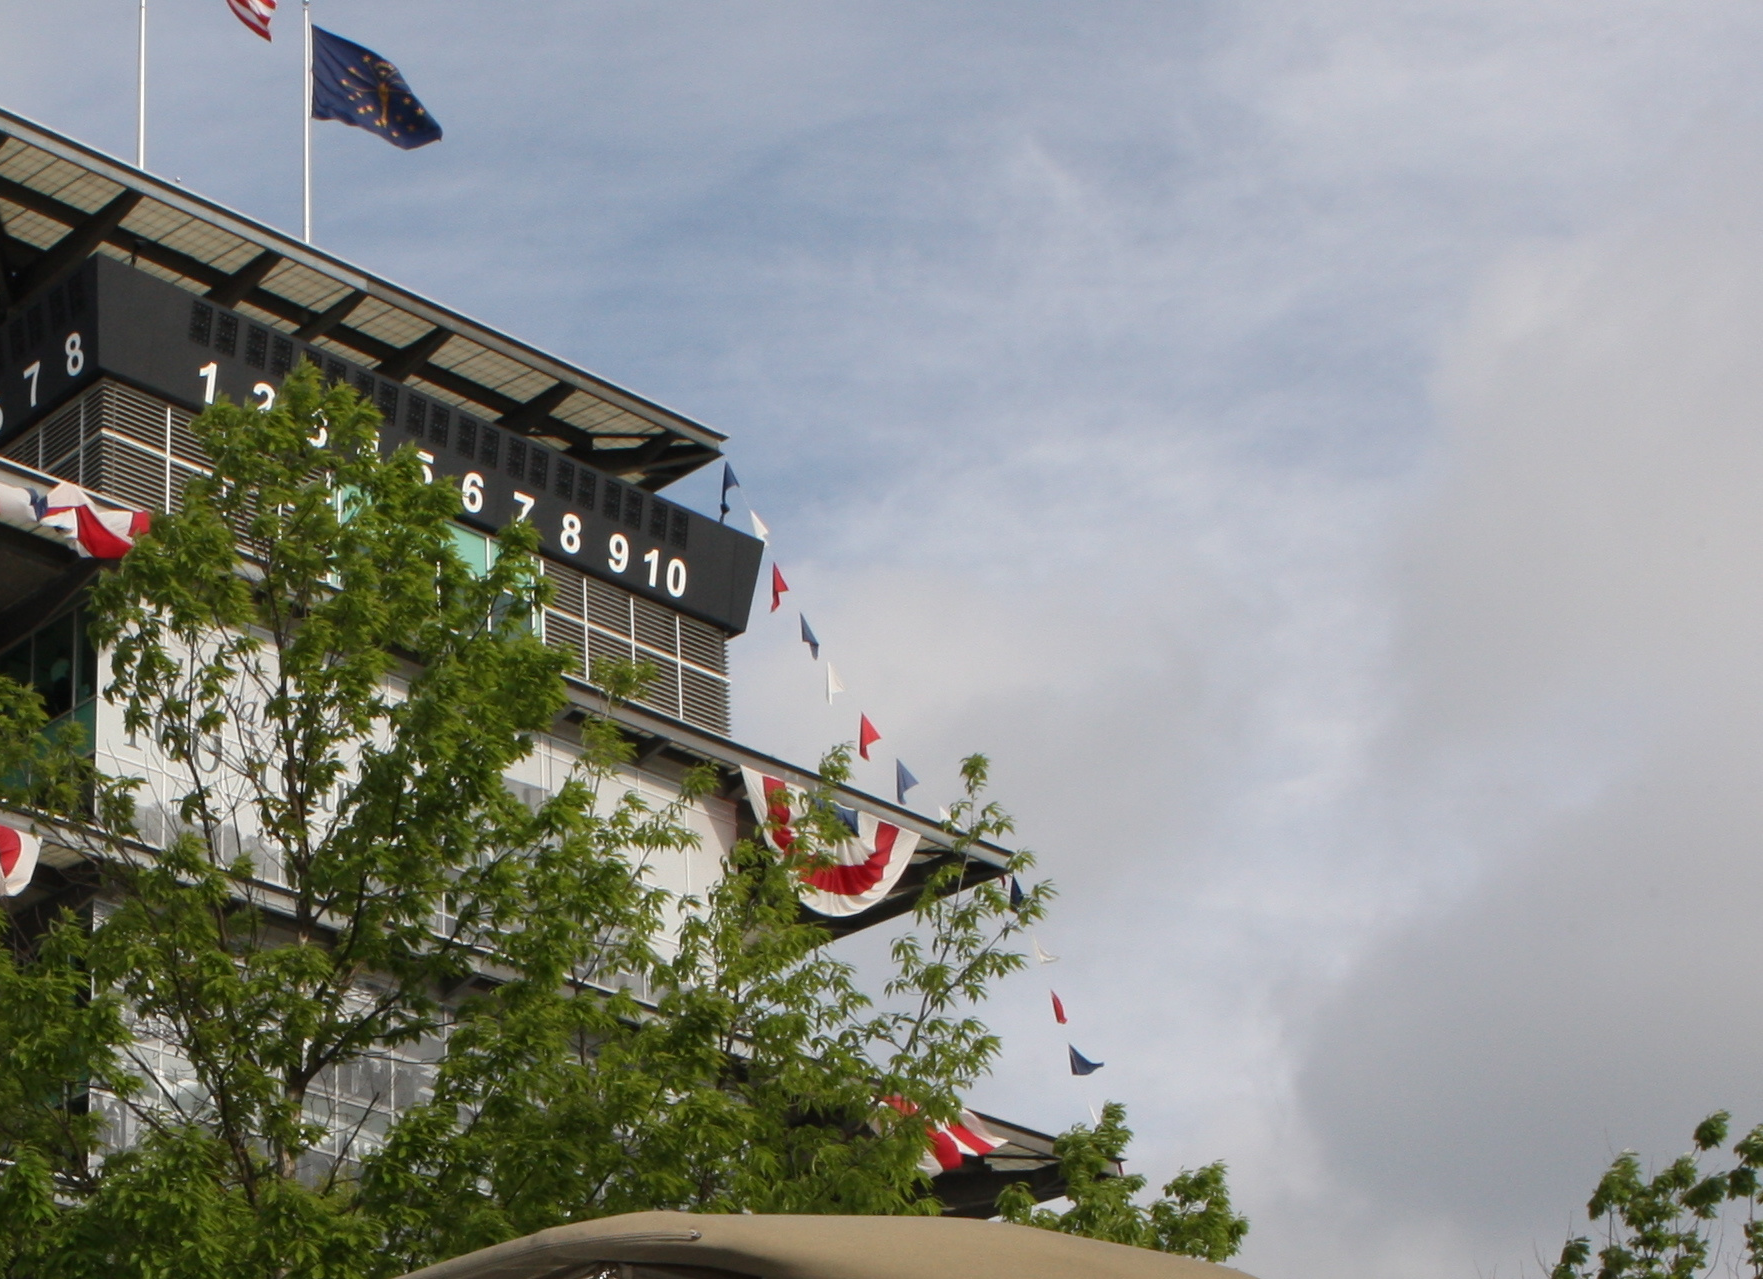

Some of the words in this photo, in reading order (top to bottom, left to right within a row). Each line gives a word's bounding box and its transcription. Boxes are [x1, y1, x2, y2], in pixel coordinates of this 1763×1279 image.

[23, 360, 40, 408] 7
[65, 332, 84, 377] 8
[199, 361, 218, 405] 1
[462, 471, 484, 513] 6
[513, 491, 535, 528] 7
[560, 512, 581, 555] 8
[608, 532, 629, 573] 9
[643, 548, 687, 598] 10
